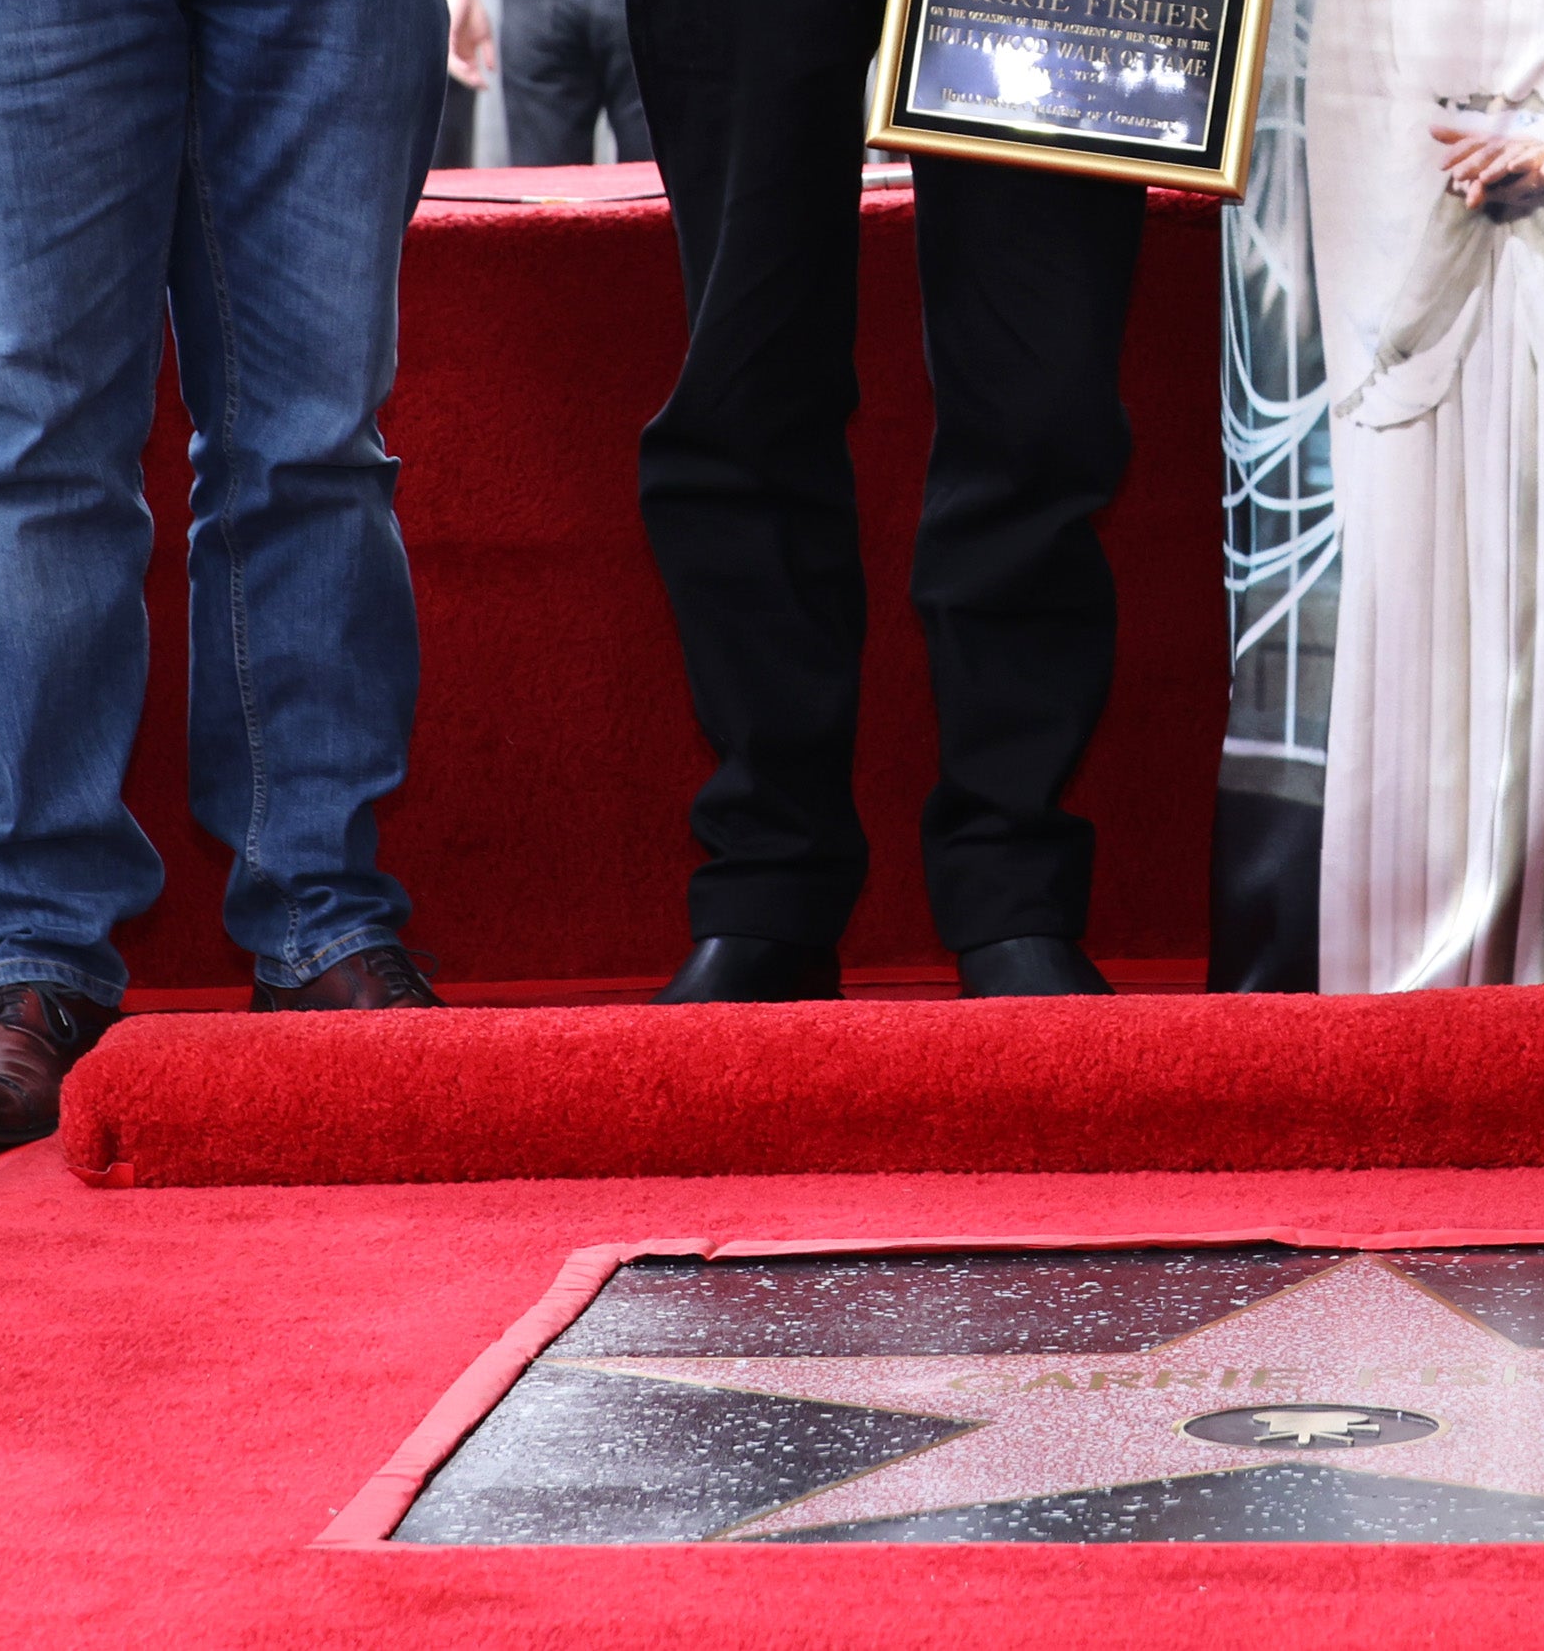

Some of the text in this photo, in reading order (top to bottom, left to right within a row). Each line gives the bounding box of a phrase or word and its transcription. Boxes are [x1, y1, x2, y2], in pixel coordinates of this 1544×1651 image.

[930, 5, 1210, 52] ON THE OCCASION OF THE PLACEMENT OF HER STAR IN THE
[1055, 41, 1113, 65] WALK
[1148, 53, 1207, 78] FAME
[947, 1367, 1312, 1393] CARRIE
